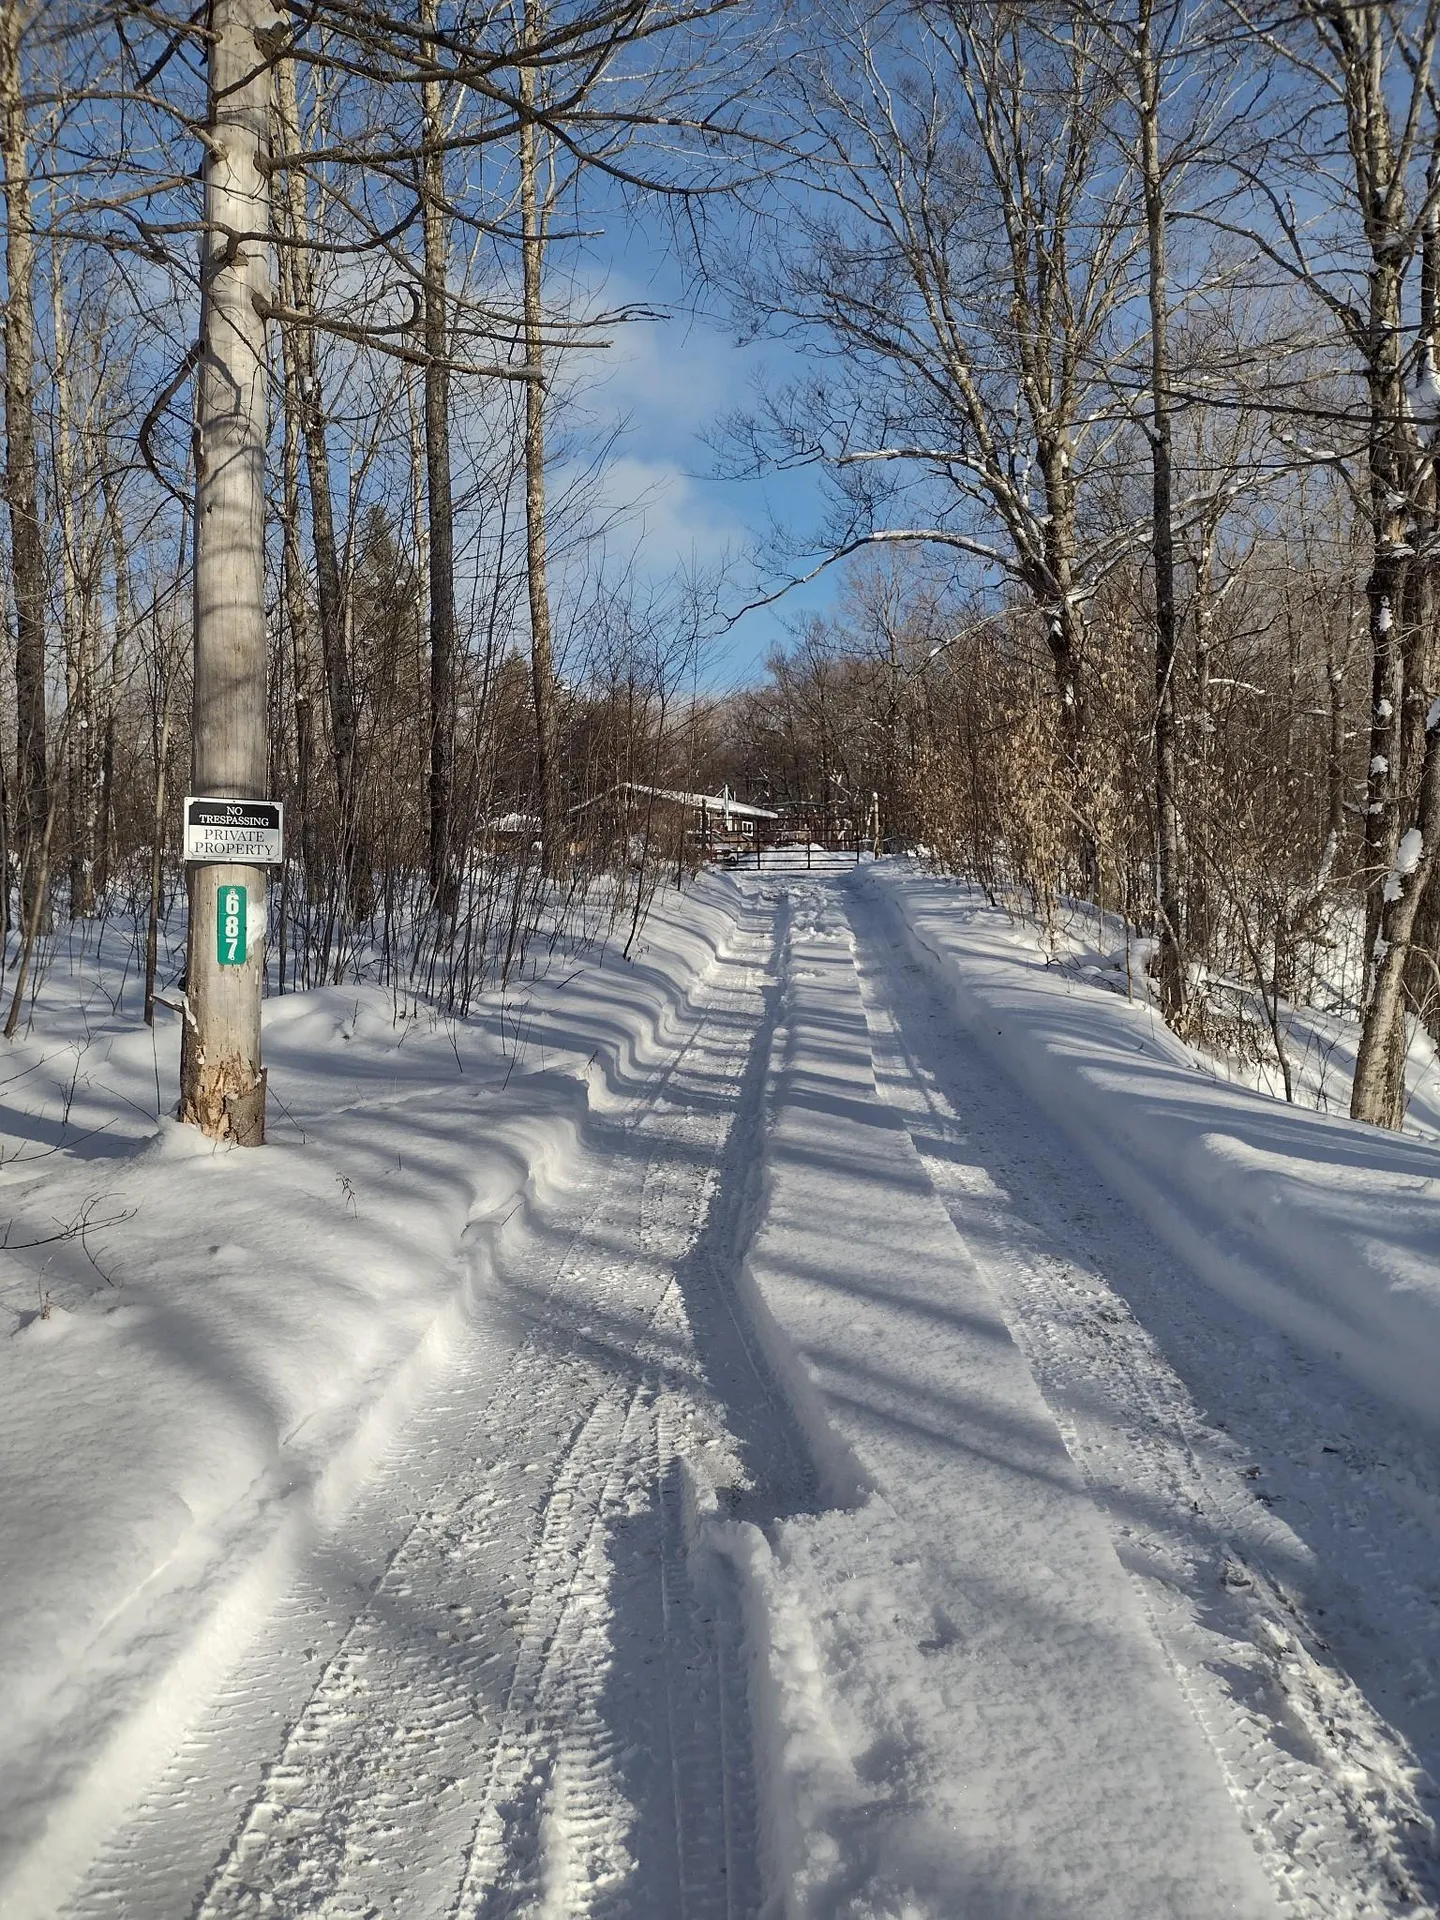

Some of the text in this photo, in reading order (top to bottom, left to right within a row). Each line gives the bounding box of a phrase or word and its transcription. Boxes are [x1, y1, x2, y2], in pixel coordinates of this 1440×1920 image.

[226, 806, 243, 815] NO
[199, 814, 269, 826] TRESPASSING
[204, 829, 264, 842] PRIVATE
[195, 842, 274, 855] PROPERTY
[225, 893, 239, 960] 687
